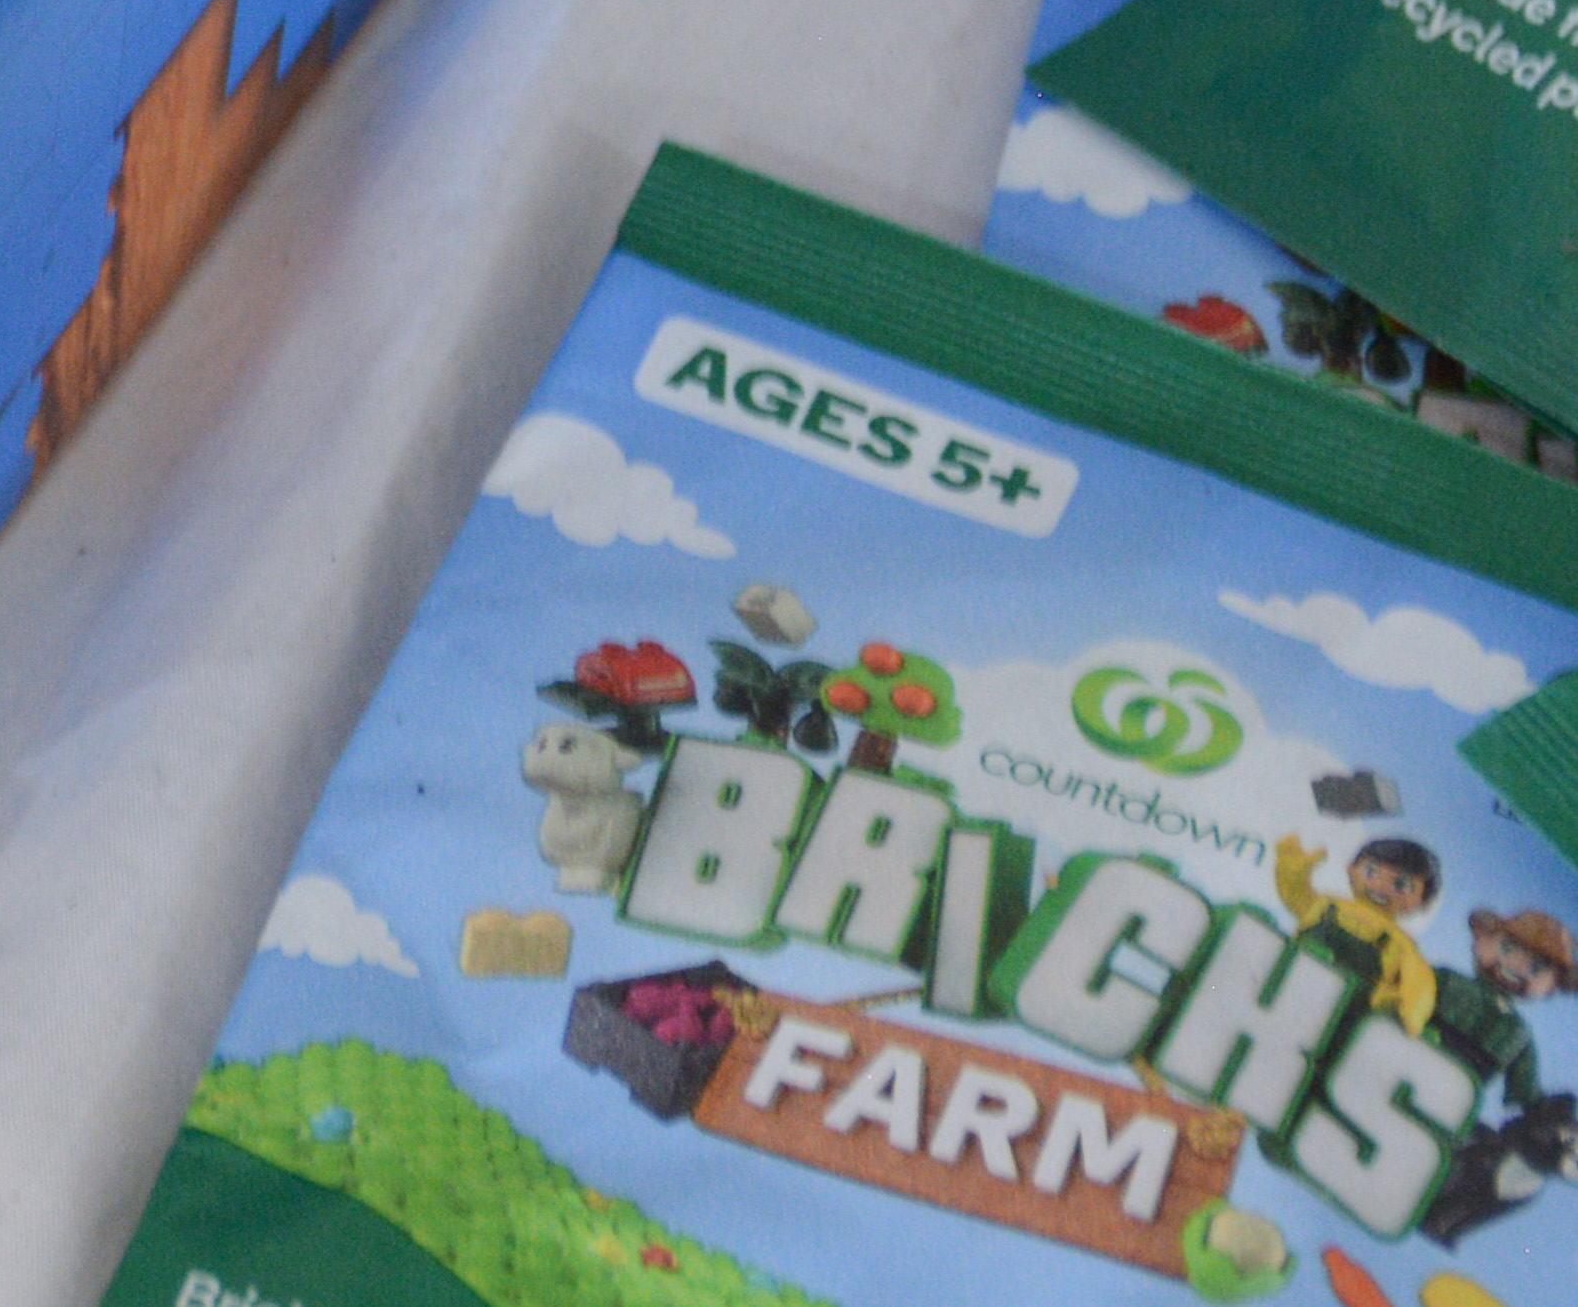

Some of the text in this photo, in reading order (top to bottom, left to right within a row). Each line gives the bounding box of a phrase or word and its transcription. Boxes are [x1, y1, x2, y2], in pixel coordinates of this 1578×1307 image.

[664, 345, 1042, 507] AGES 5+
[979, 743, 1273, 867] countdown
[743, 1011, 1183, 1223] FARM
